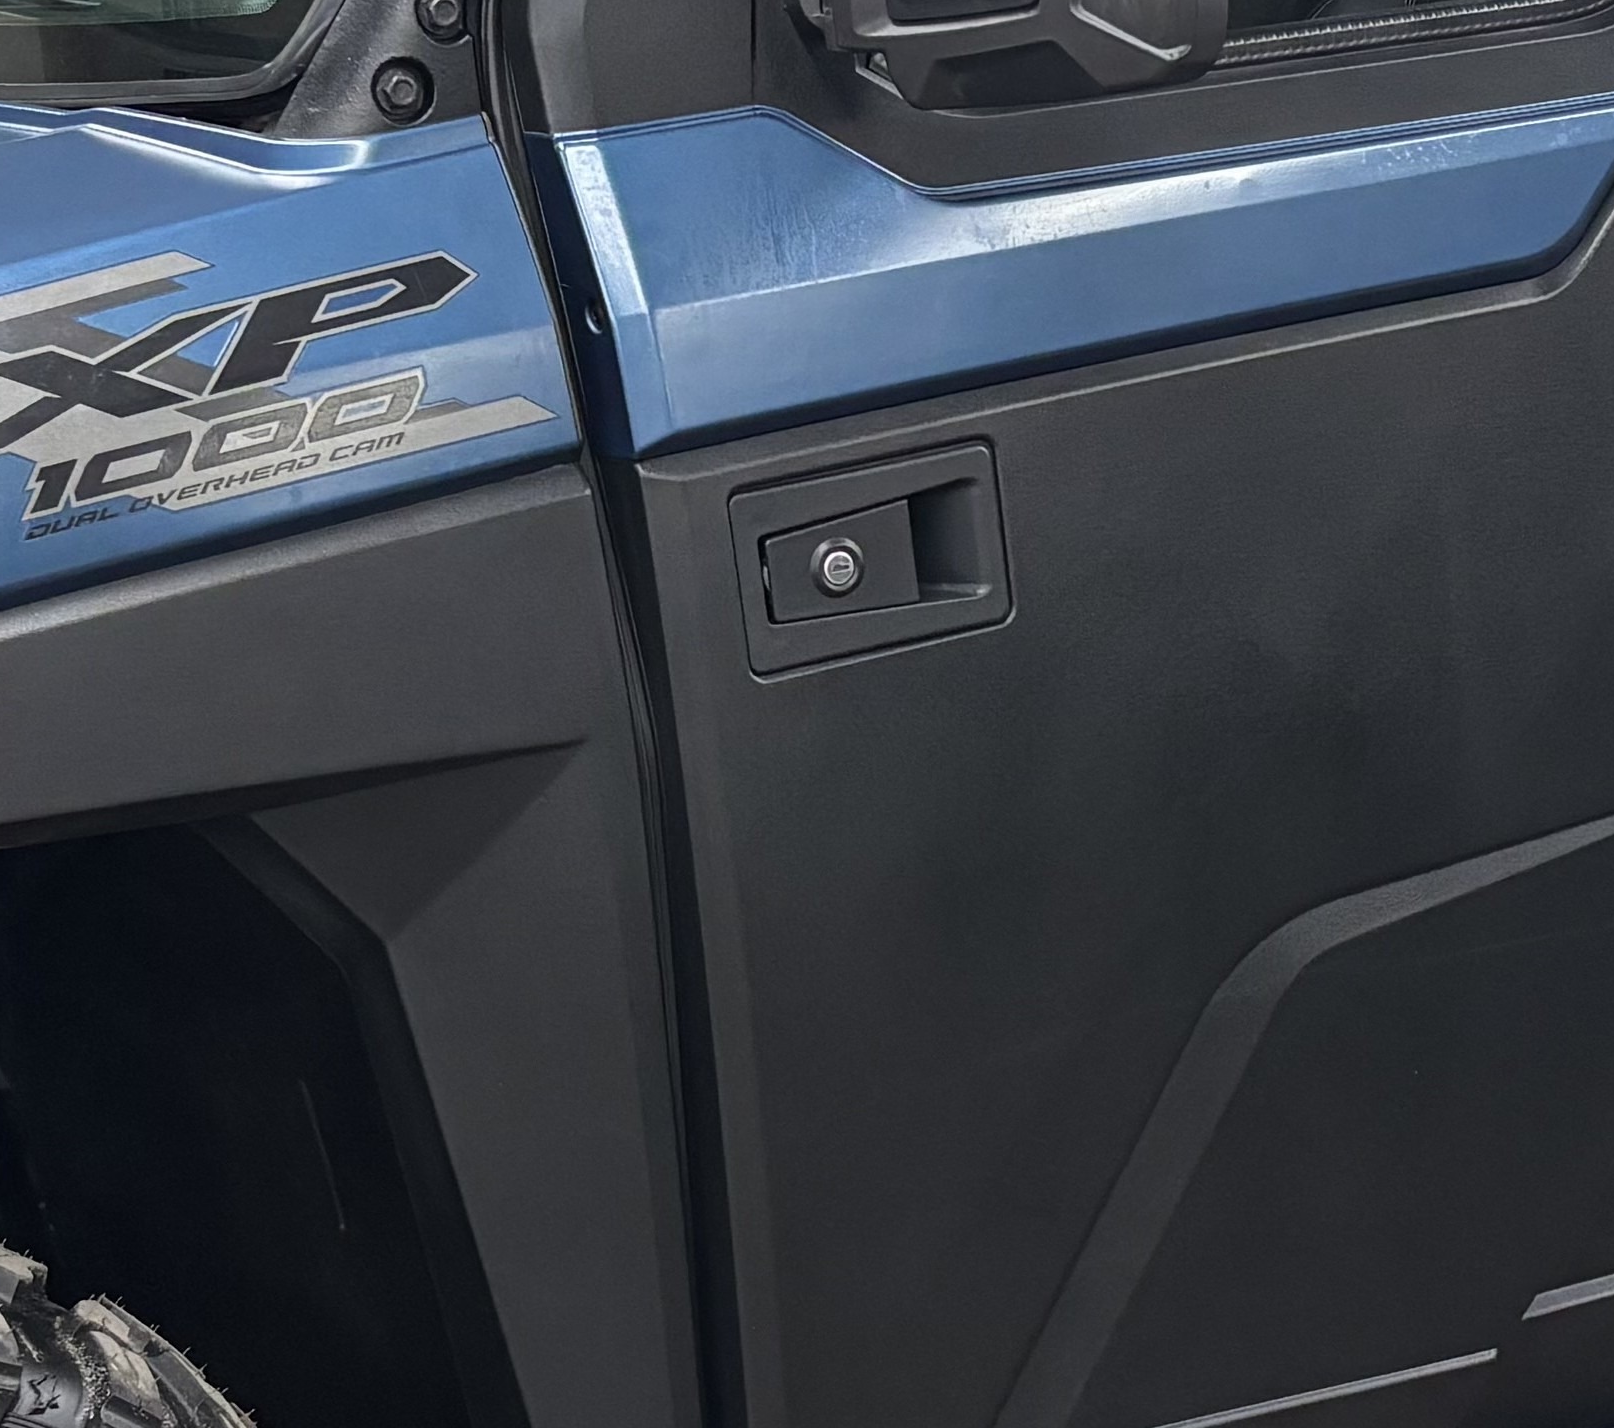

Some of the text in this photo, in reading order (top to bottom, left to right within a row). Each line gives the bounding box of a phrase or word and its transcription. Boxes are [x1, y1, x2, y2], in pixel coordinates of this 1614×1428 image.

[24, 367, 425, 518] 1000
[24, 431, 406, 541] DUAL OVERHEAD CAM
